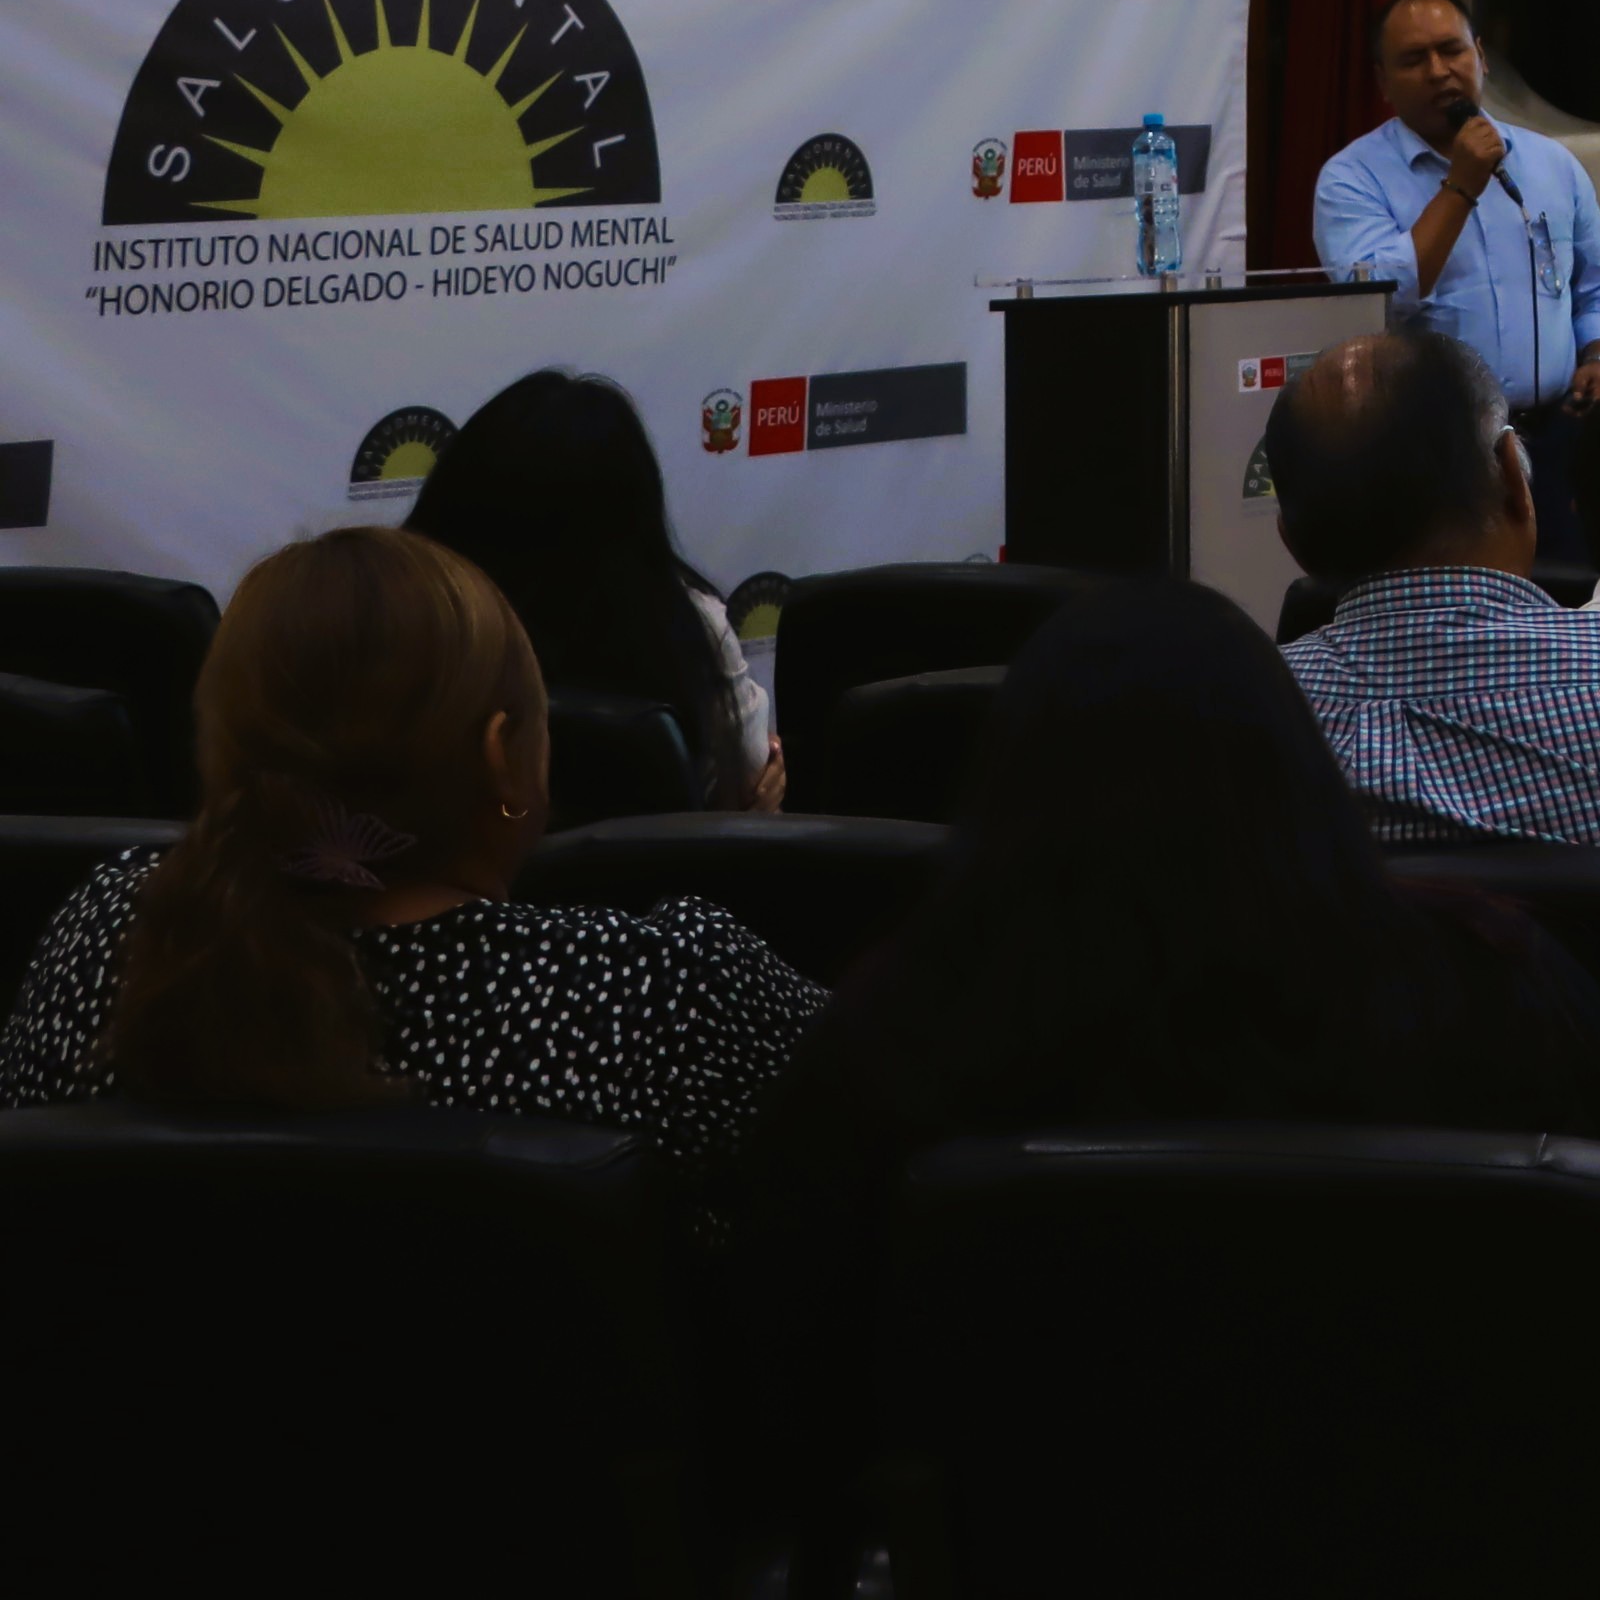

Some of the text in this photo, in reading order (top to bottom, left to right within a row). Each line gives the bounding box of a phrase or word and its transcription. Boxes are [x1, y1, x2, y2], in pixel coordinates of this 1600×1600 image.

[1017, 152, 1057, 177] PERÚ
[93, 216, 675, 272] INSTITUTO NACIONAL DE SALUD MENTAL
[263, 270, 408, 308] DELGADO
[432, 263, 537, 298] HIDEYO
[757, 400, 800, 427] PERÚ
